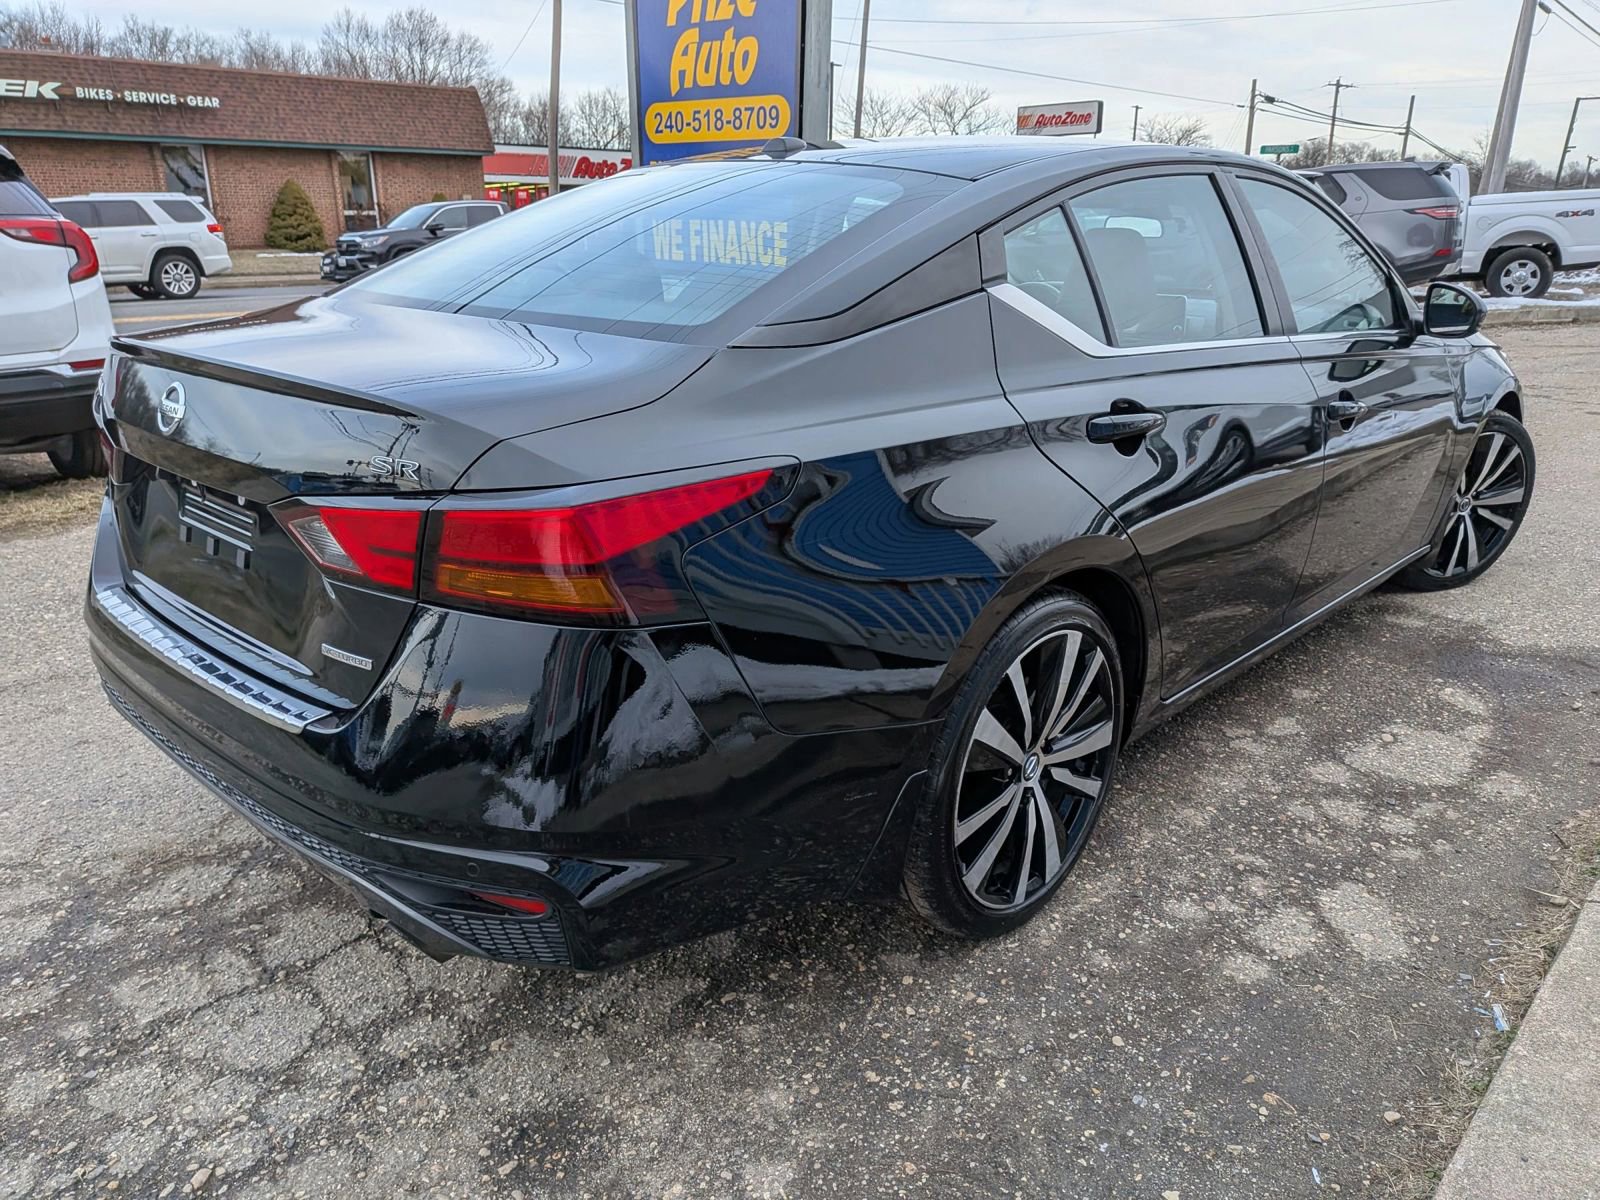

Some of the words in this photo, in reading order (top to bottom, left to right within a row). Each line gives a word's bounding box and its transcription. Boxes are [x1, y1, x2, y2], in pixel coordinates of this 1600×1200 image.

[669, 26, 759, 98] Auto
[75, 86, 114, 101] BIKES
[124, 90, 177, 105] SERVICE
[186, 95, 220, 108] GEAR
[653, 104, 780, 135] 240-518-8709
[1034, 111, 1092, 128] AutoZone
[653, 219, 684, 262] WE
[689, 219, 788, 267] FINANCE
[370, 455, 420, 481] SR
